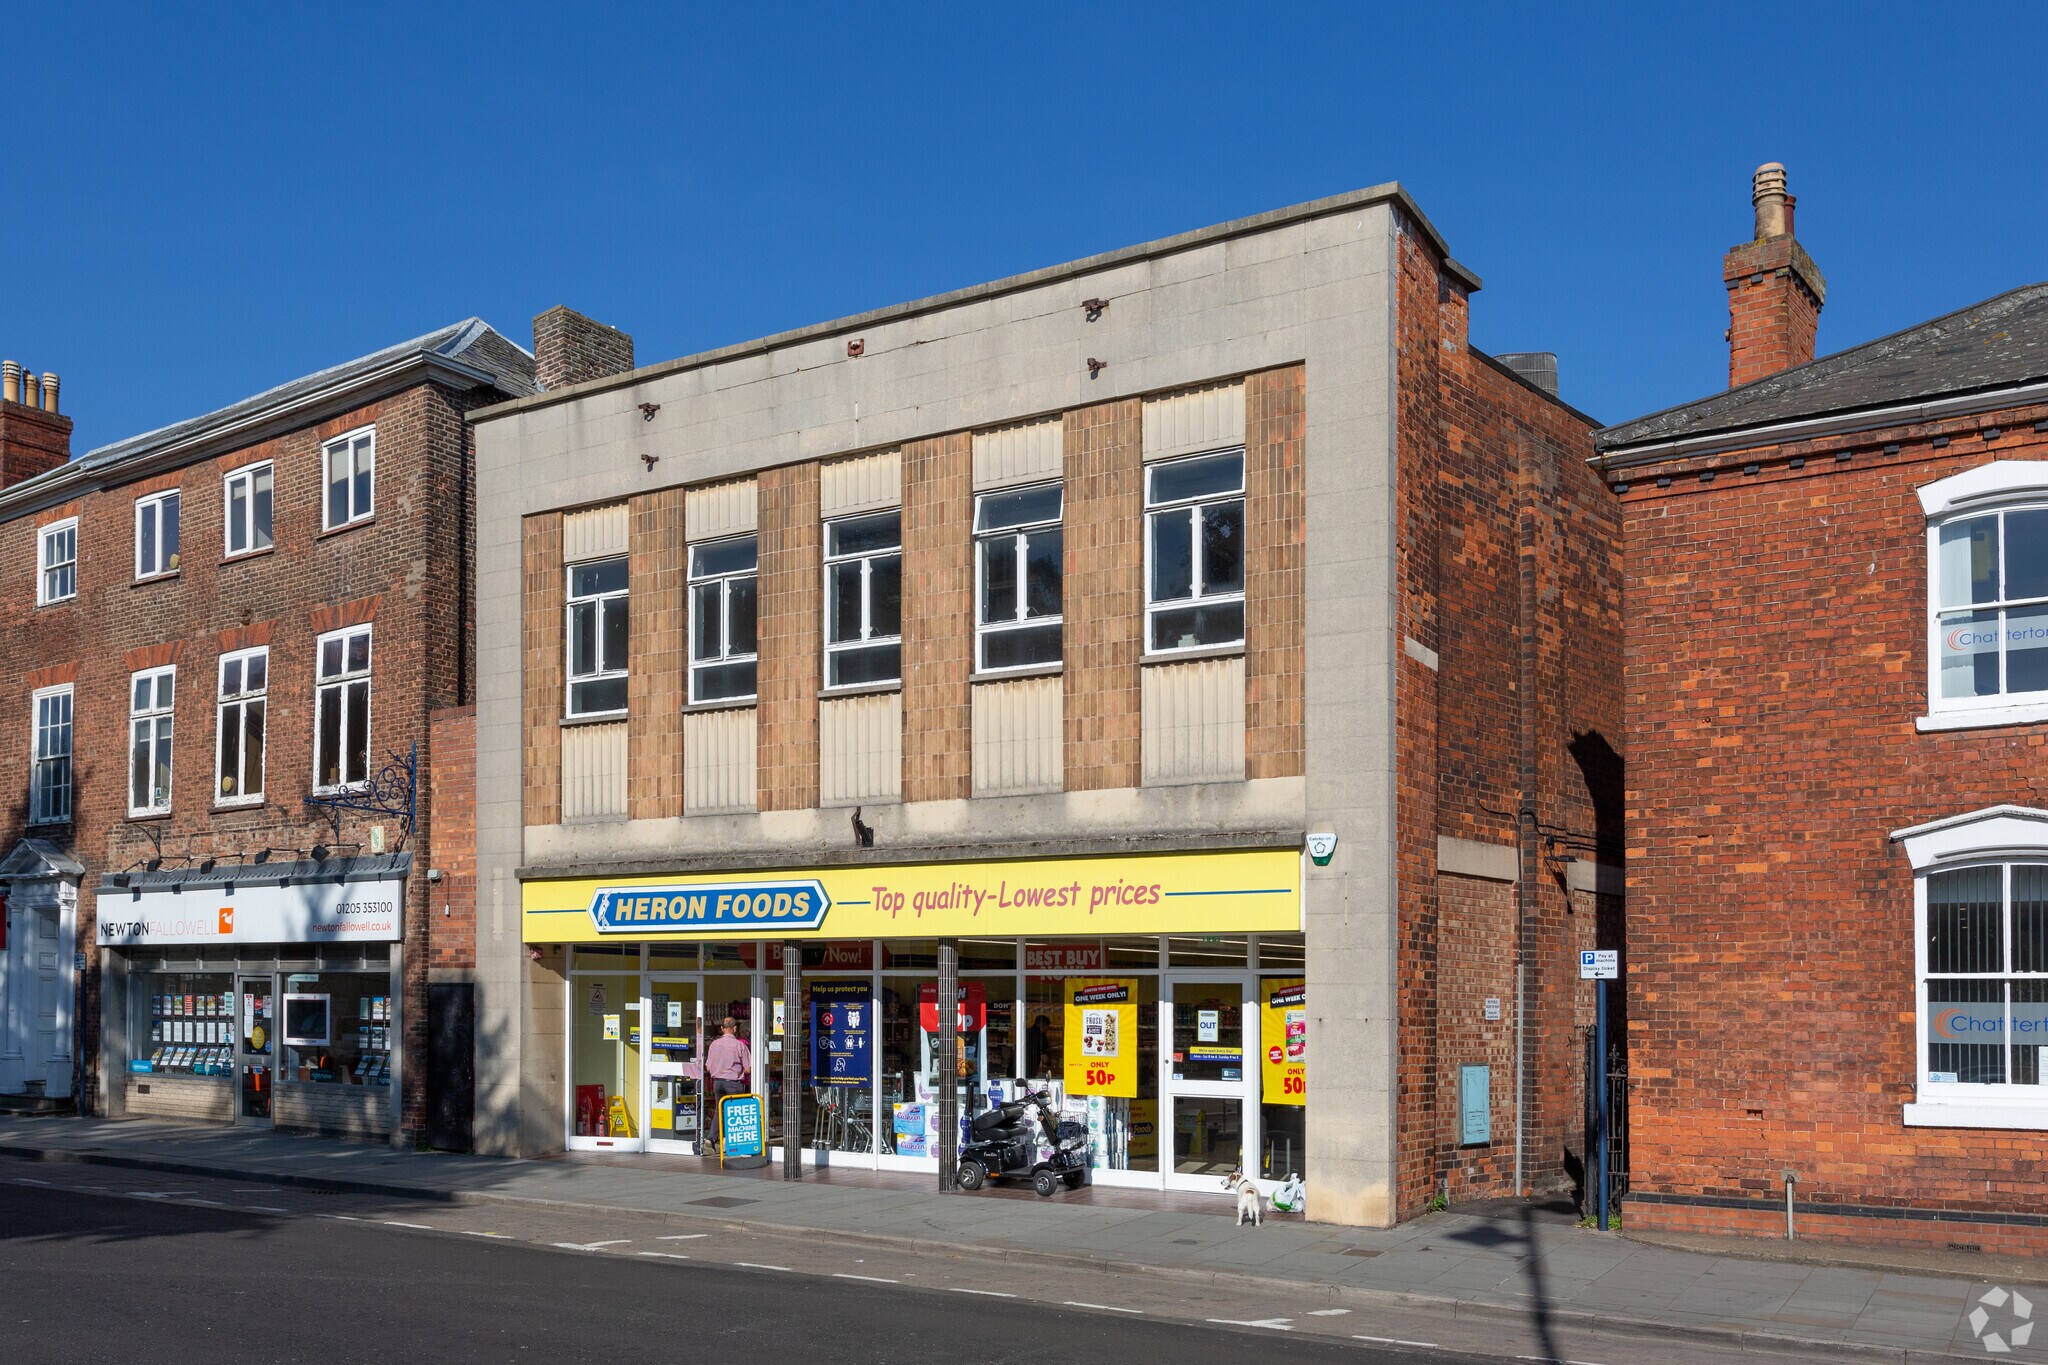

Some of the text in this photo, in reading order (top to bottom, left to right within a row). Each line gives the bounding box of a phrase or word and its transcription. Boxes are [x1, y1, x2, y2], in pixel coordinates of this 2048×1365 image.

[1960, 627, 2048, 645] Chatterto
[872, 886, 905, 919] Top
[1089, 878, 1161, 915] prices
[336, 902, 392, 914] 01205 353100
[615, 891, 810, 921] HERON FOODS
[312, 921, 391, 933] newtonfallowell.co.uk
[829, 946, 862, 963] Now!
[1027, 950, 1100, 966] BEST BUY
[812, 986, 825, 994] Help
[835, 986, 856, 994] protect
[1089, 993, 1107, 1001] WEEK
[1107, 991, 1126, 999] ONLY!
[1285, 994, 1301, 1002] WEEK
[1200, 1021, 1217, 1029] OUT
[727, 1104, 757, 1117] FREE
[727, 1115, 757, 1127] CASH
[728, 1131, 758, 1143] HERE
